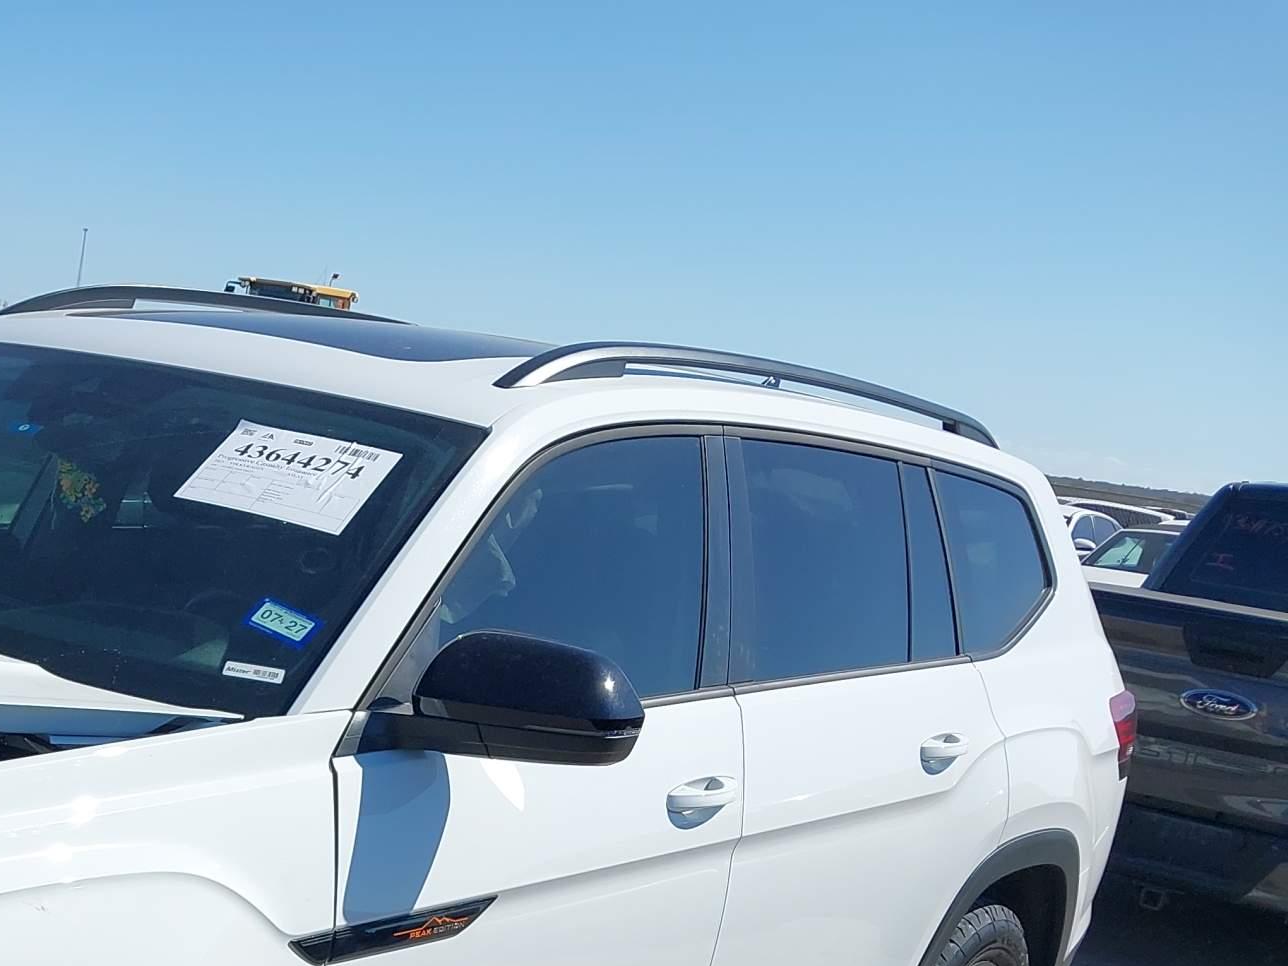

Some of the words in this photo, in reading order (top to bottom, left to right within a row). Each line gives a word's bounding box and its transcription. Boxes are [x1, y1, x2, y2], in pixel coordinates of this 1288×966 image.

[234, 443, 365, 479] 43644274
[260, 610, 283, 623] 07
[284, 620, 308, 634] 27
[1196, 694, 1240, 715] Ford
[409, 928, 432, 939] PEAK
